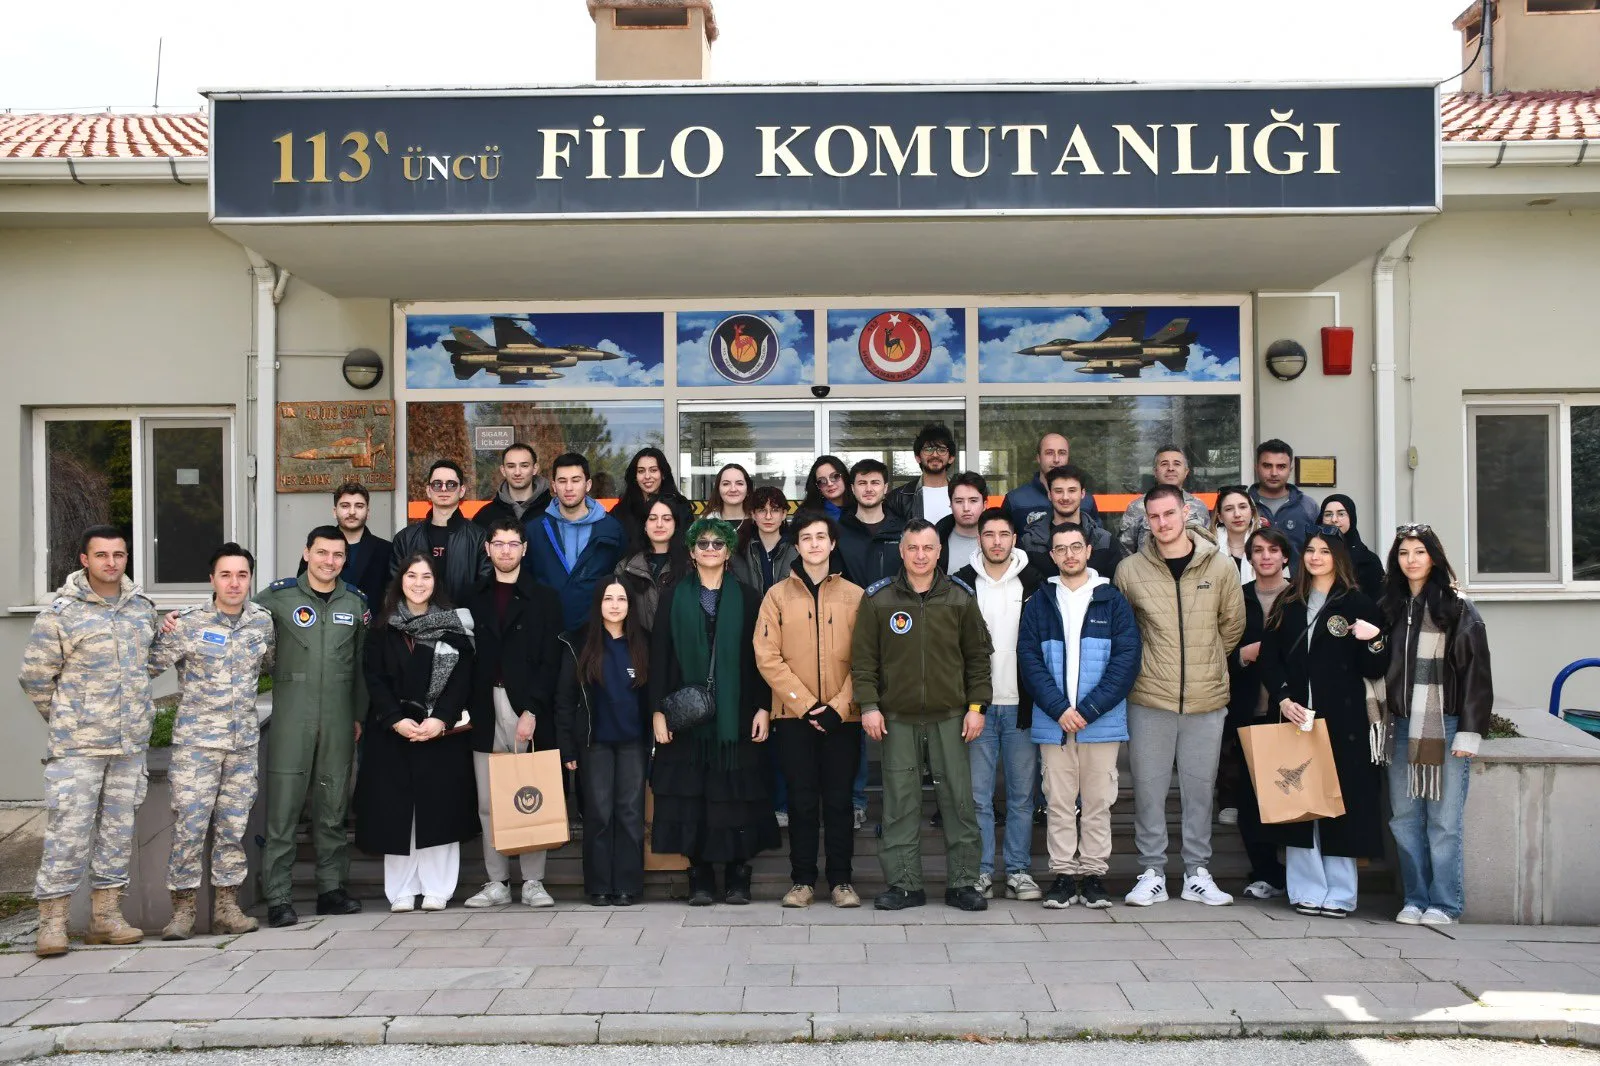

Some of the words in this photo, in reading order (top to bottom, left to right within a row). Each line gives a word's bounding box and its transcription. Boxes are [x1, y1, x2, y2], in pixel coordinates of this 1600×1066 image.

[402, 145, 502, 181] ÜNCÜ
[536, 115, 725, 179] FİLO
[755, 109, 1341, 178] KOMUTANLIĞI
